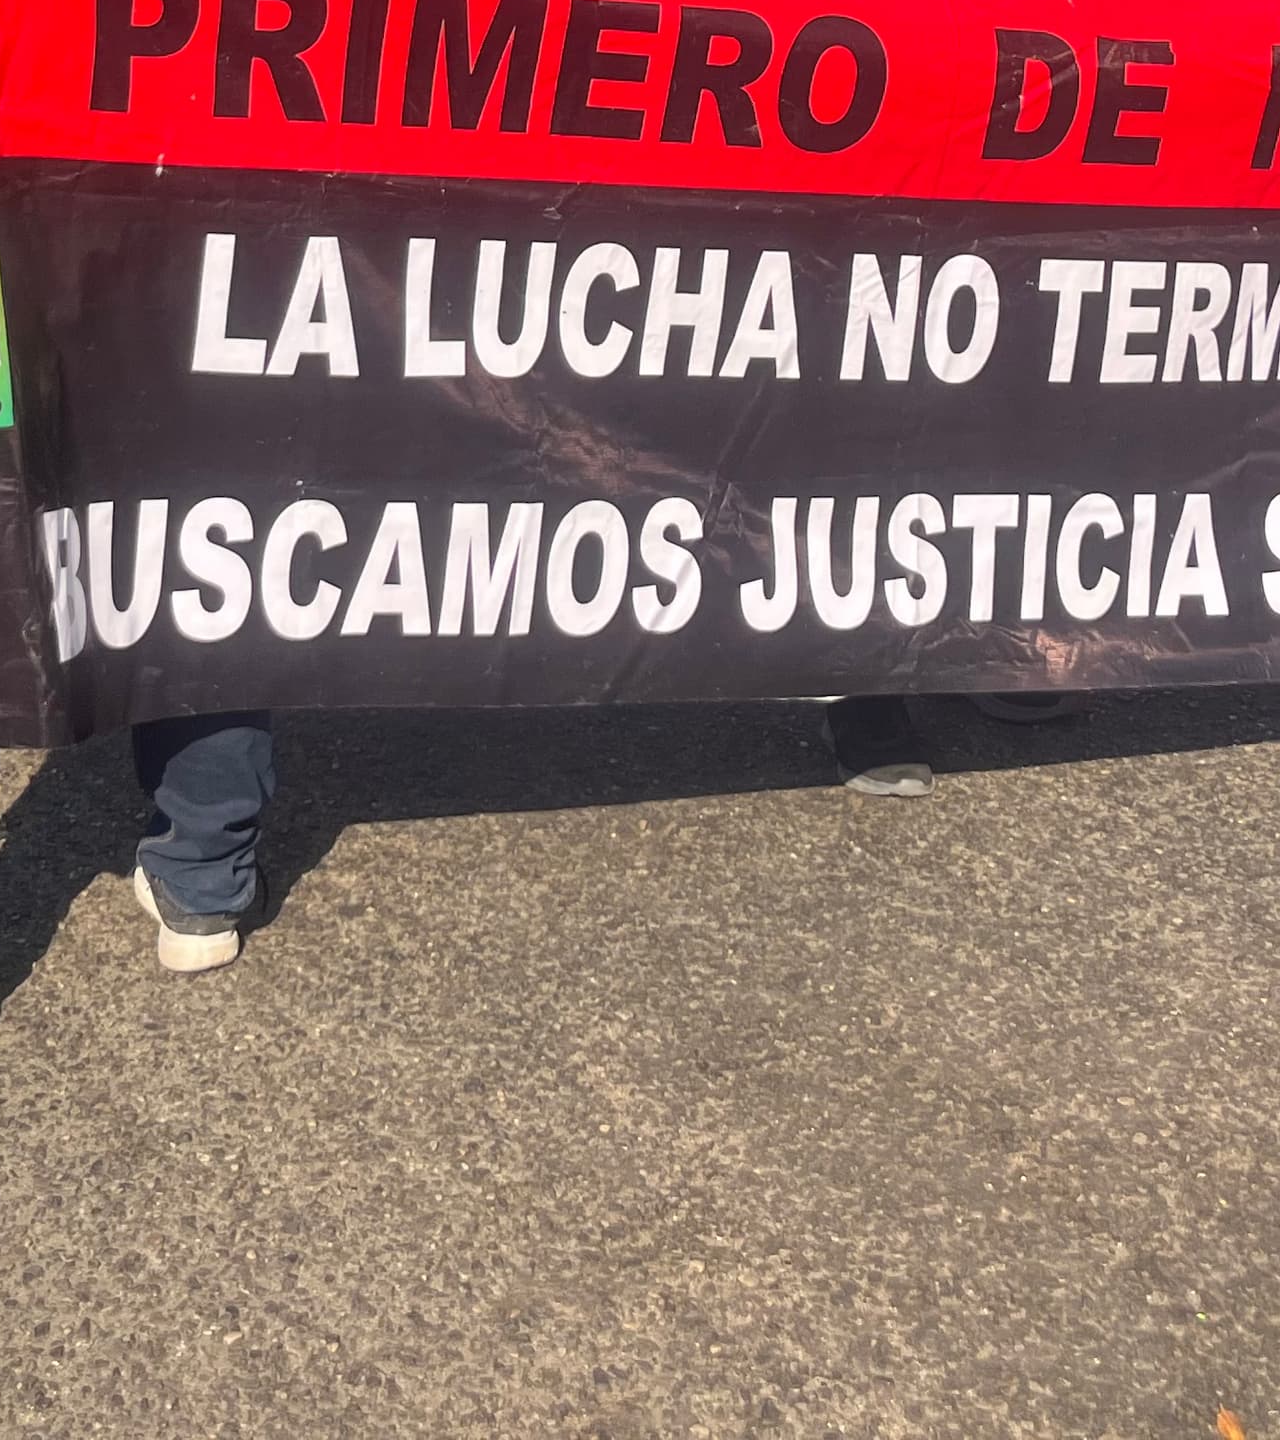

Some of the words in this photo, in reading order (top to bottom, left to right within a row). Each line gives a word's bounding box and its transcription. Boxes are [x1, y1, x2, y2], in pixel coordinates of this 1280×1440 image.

[981, 28, 1177, 167] DE
[190, 234, 360, 379] LA
[403, 237, 801, 381] LUCHA
[839, 253, 1001, 385] NO
[40, 496, 705, 665] BUSCAMOS
[739, 492, 1230, 634] JUSTICIA
